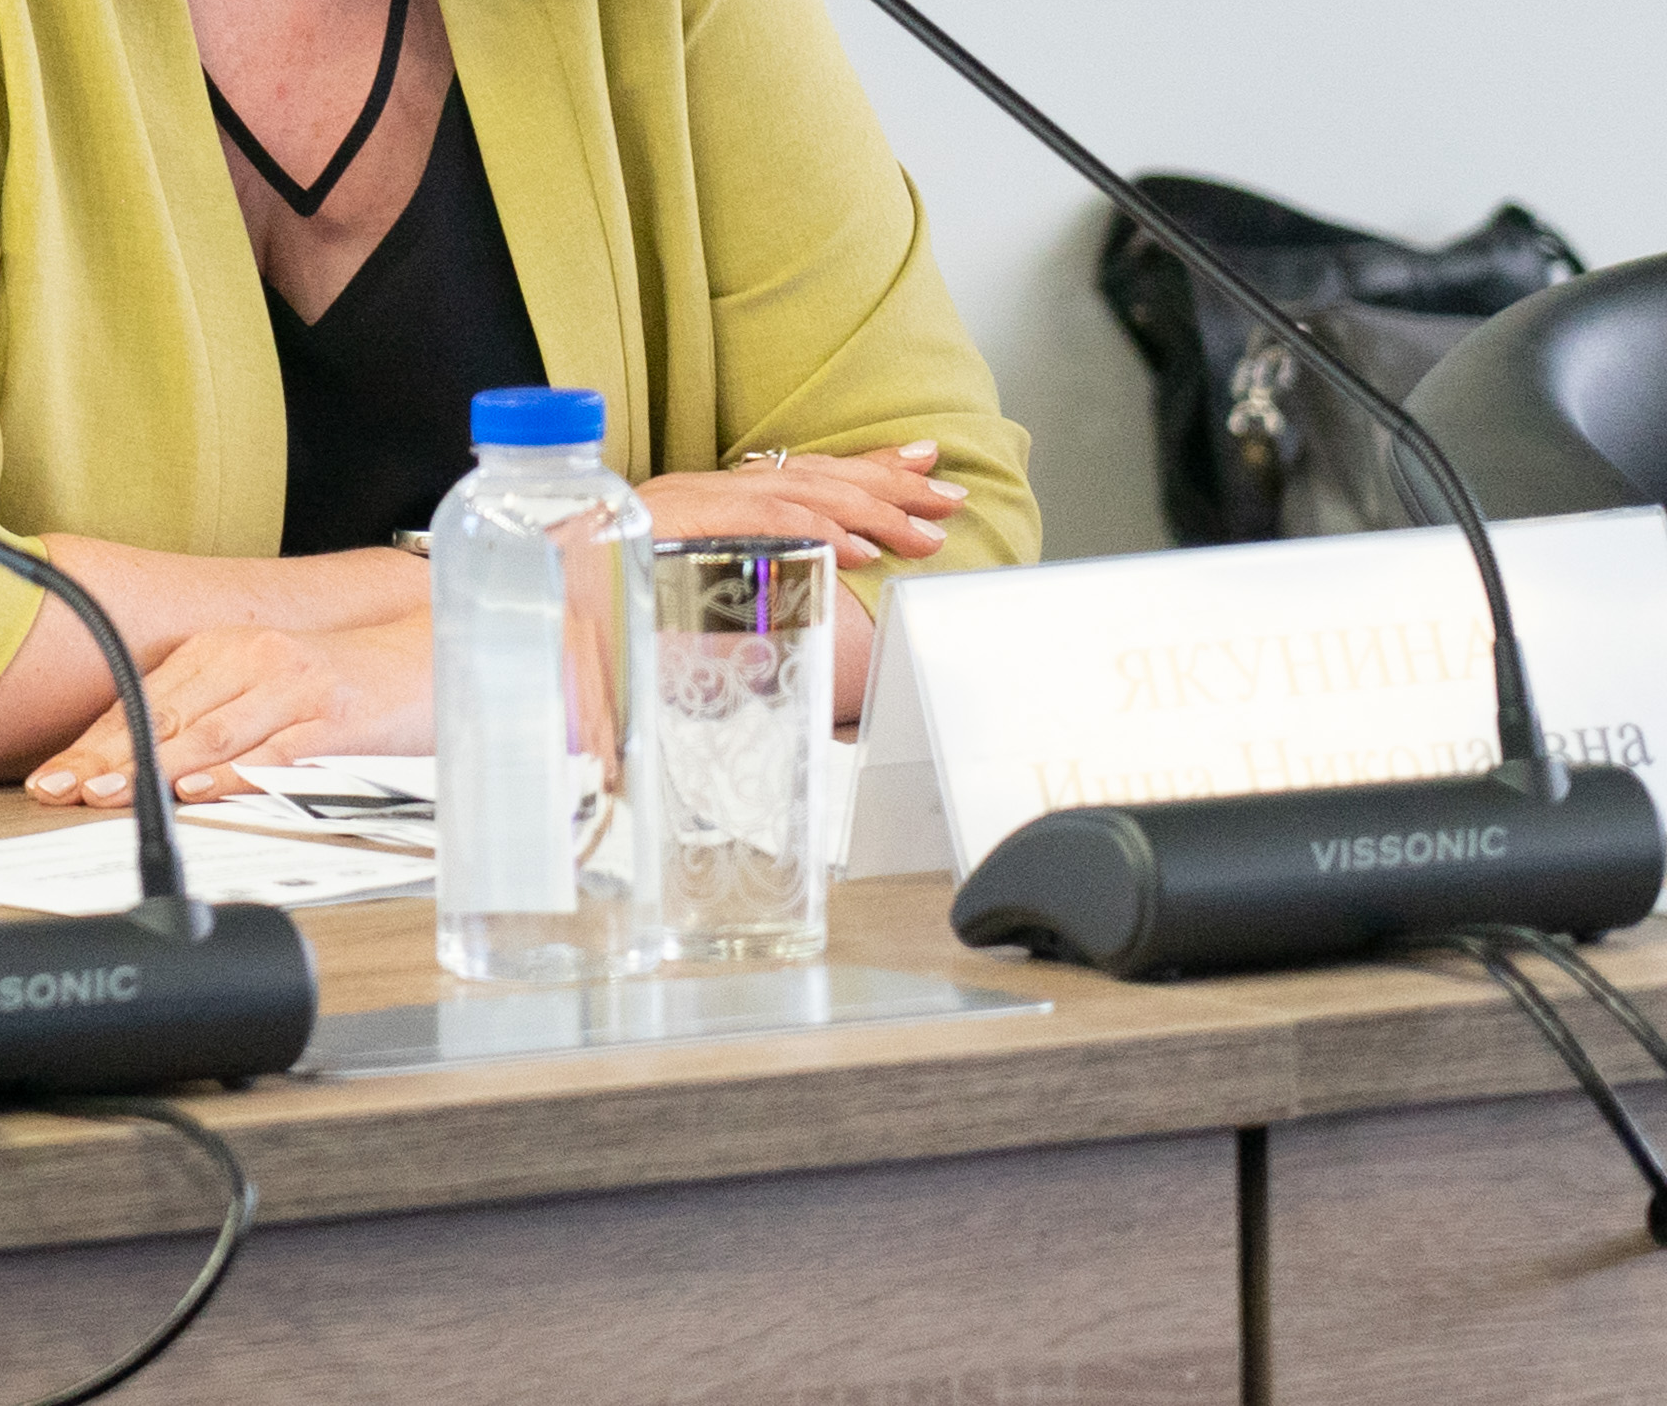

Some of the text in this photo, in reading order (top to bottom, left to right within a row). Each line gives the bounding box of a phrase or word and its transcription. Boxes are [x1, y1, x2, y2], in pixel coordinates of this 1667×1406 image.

[1113, 615, 1495, 713] ЯКУНИНА
[1236, 721, 1655, 790] Николавна
[1310, 824, 1509, 874] VISSONIC
